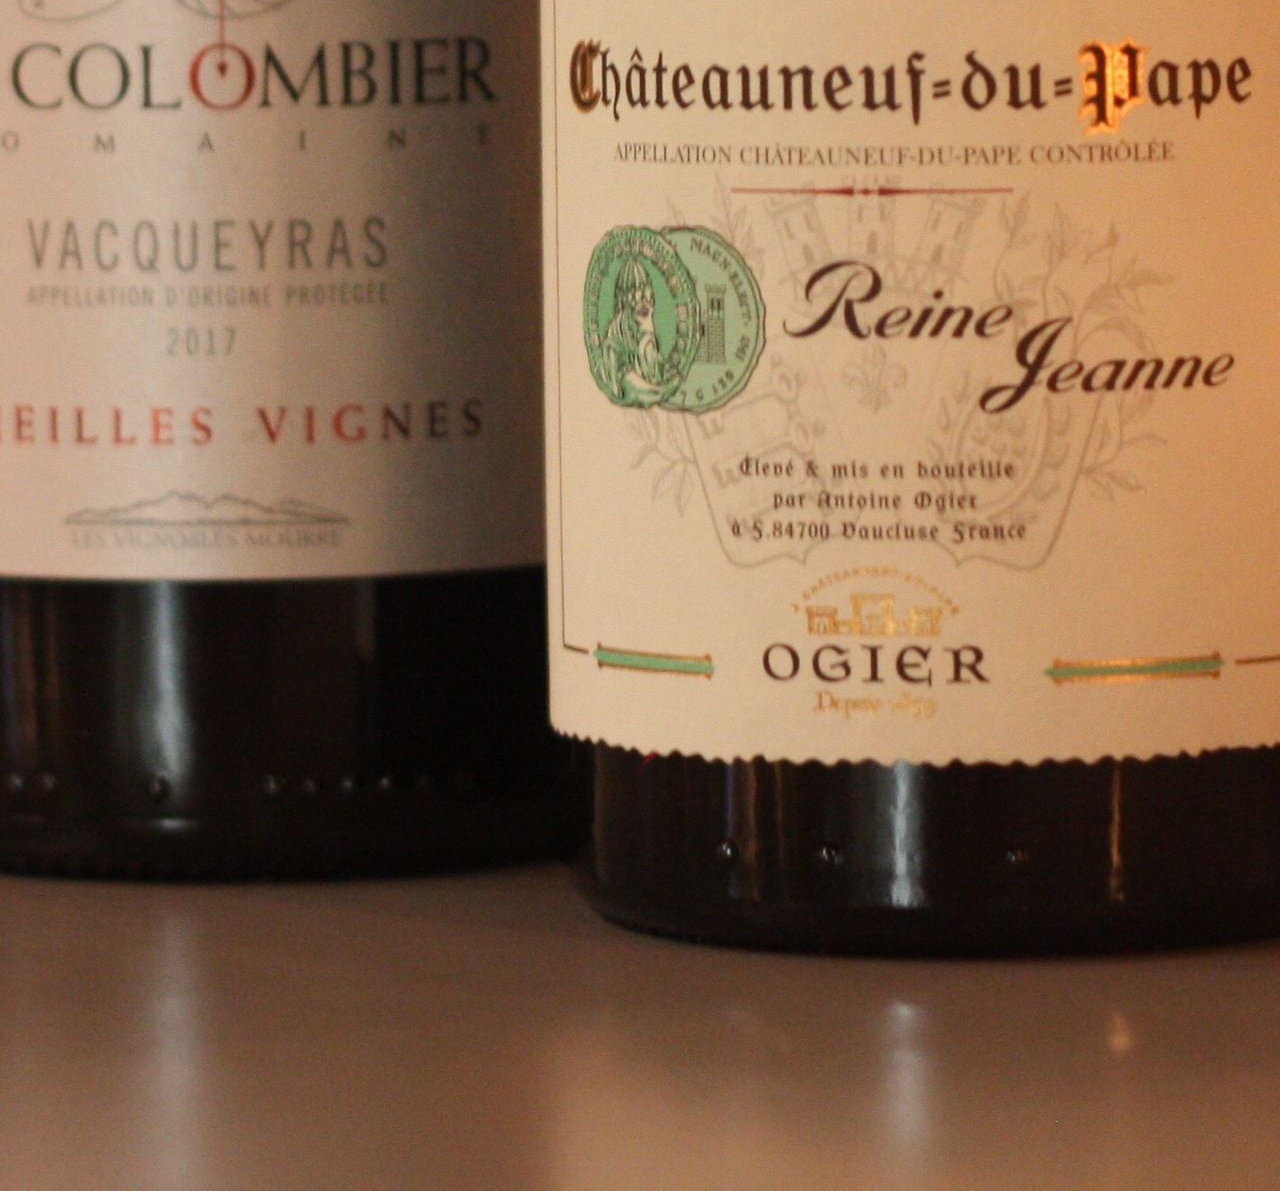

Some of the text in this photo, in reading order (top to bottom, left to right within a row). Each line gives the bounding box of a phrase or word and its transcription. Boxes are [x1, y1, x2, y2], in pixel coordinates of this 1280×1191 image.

[10, 37, 497, 111] COLOMBIER
[614, 140, 732, 166] APPELLATION
[25, 213, 391, 275] VACQUEYRAS
[26, 283, 156, 309] APPELLATION
[165, 285, 275, 309] D'ORIGINE
[782, 259, 1014, 340] Reine
[166, 327, 239, 358] 2017
[978, 315, 1236, 414] Jeanne
[255, 398, 486, 447] VIGNES
[805, 459, 819, 478] &
[832, 460, 869, 479] mis
[879, 463, 905, 479] en
[917, 459, 1016, 480] bouteille
[772, 491, 806, 511] par
[762, 642, 992, 688] OGIER
